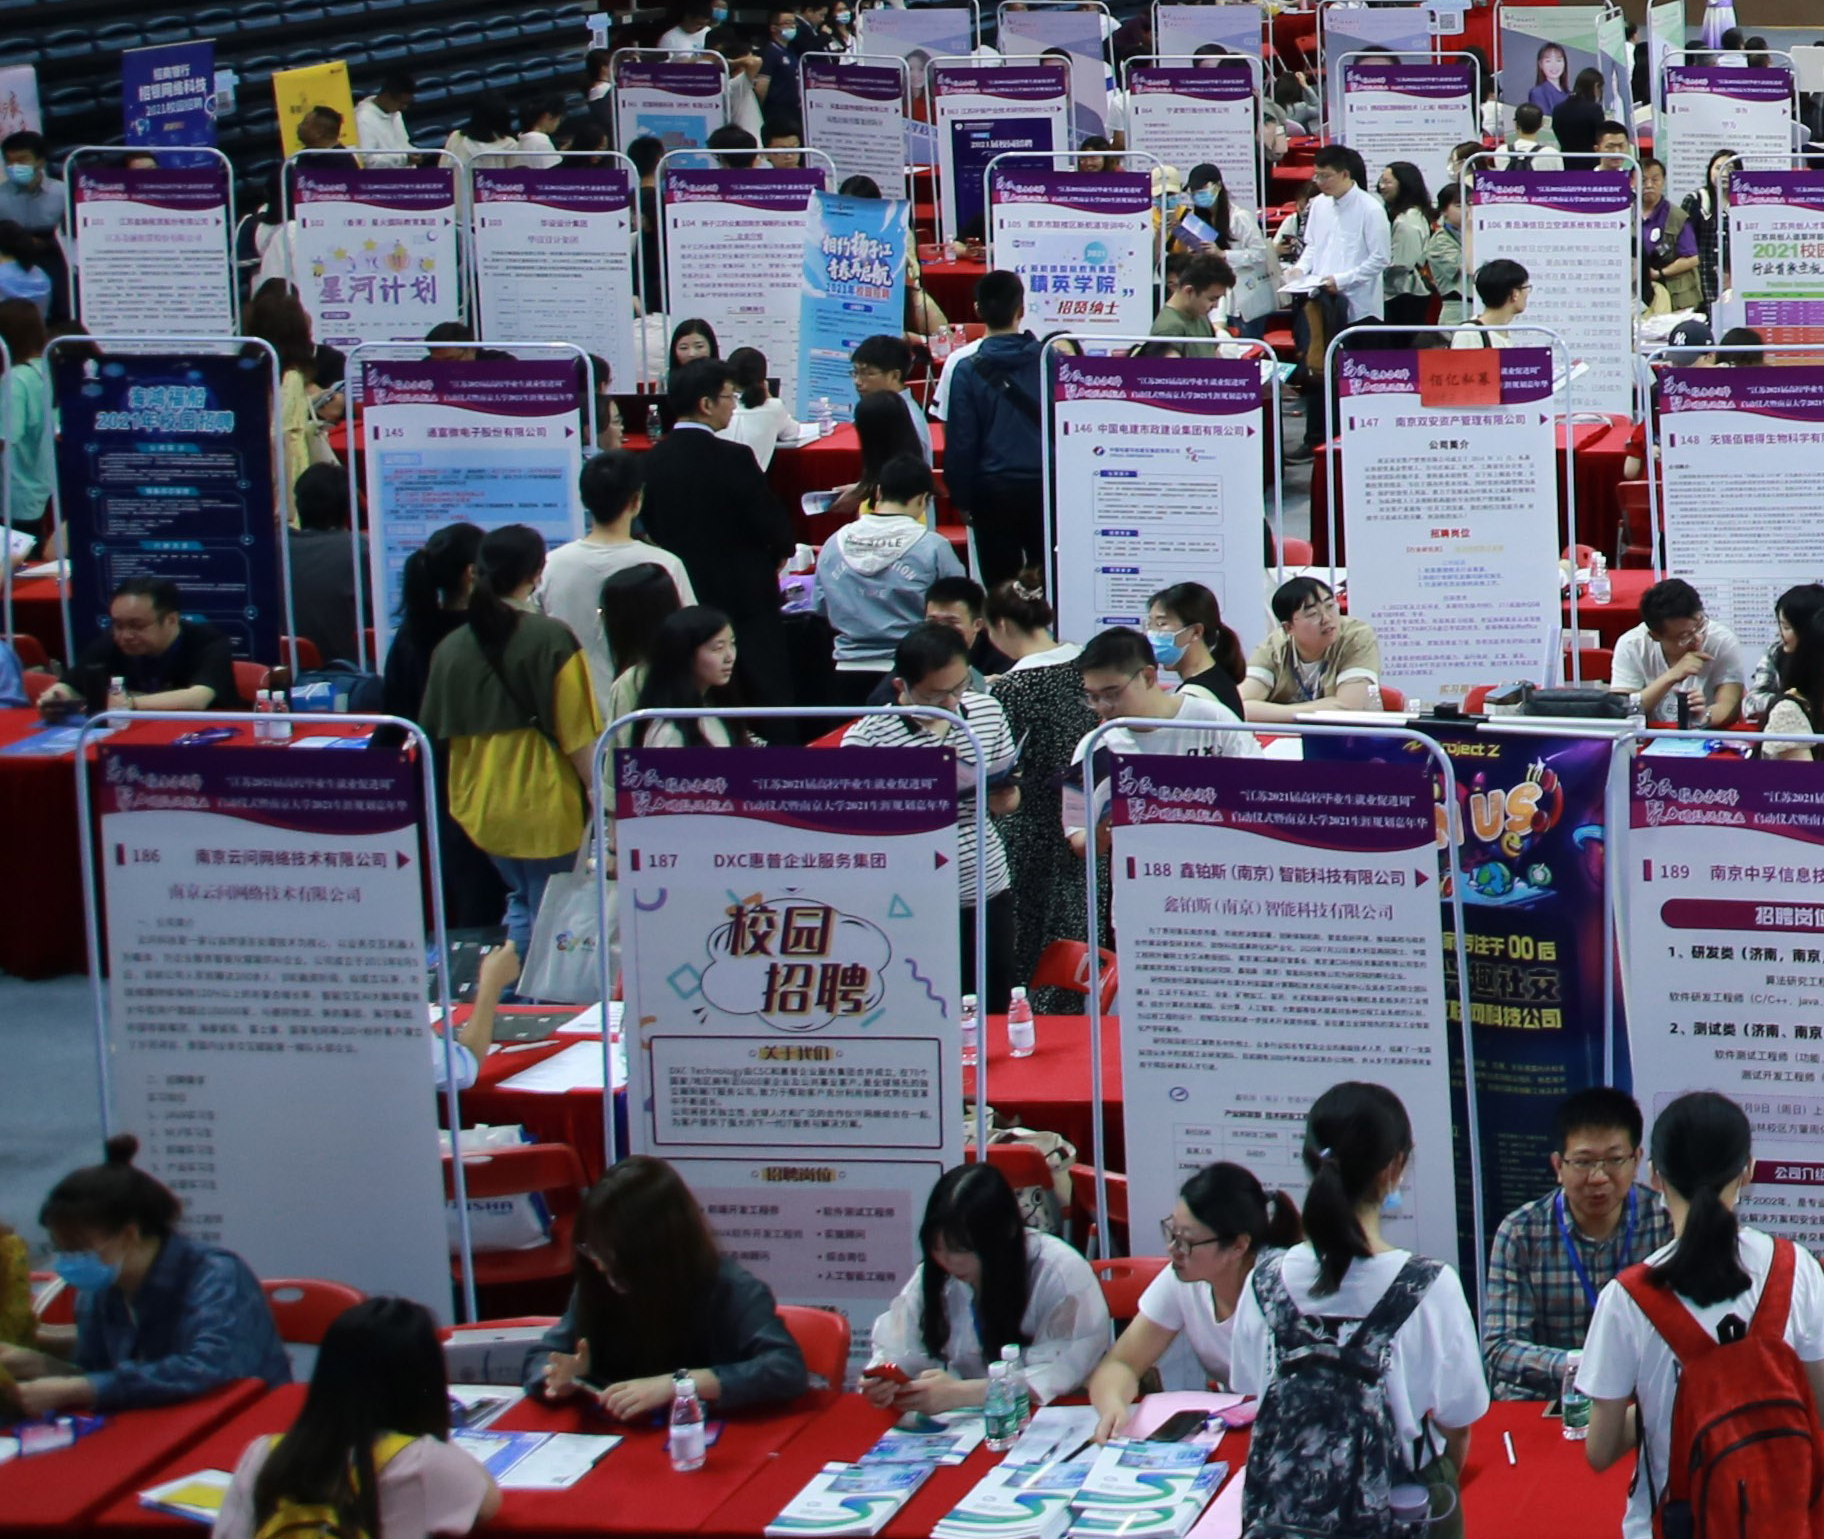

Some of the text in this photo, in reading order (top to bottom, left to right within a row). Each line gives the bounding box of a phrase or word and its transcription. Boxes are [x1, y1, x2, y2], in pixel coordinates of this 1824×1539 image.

[319, 276, 438, 305] 星河计划
[1029, 274, 1116, 294] 精英学院
[1360, 414, 1526, 427] 147 南京双安资产管理有限公司
[427, 427, 547, 438] 通富微电子股份有限公司
[1074, 423, 1245, 437] 146 中国电建市政建设集团有限公司
[1681, 435, 1700, 445] 148
[133, 849, 387, 868] 186 南京云问网络技术有限公司
[649, 853, 887, 869] 187 DXC惠普企业服务集团
[1144, 862, 1405, 886] 188 鑫铂斯（南京）智能科技有限公司
[1661, 866, 1690, 879] 189
[728, 905, 835, 956] 校园
[763, 962, 869, 1016] 招聘
